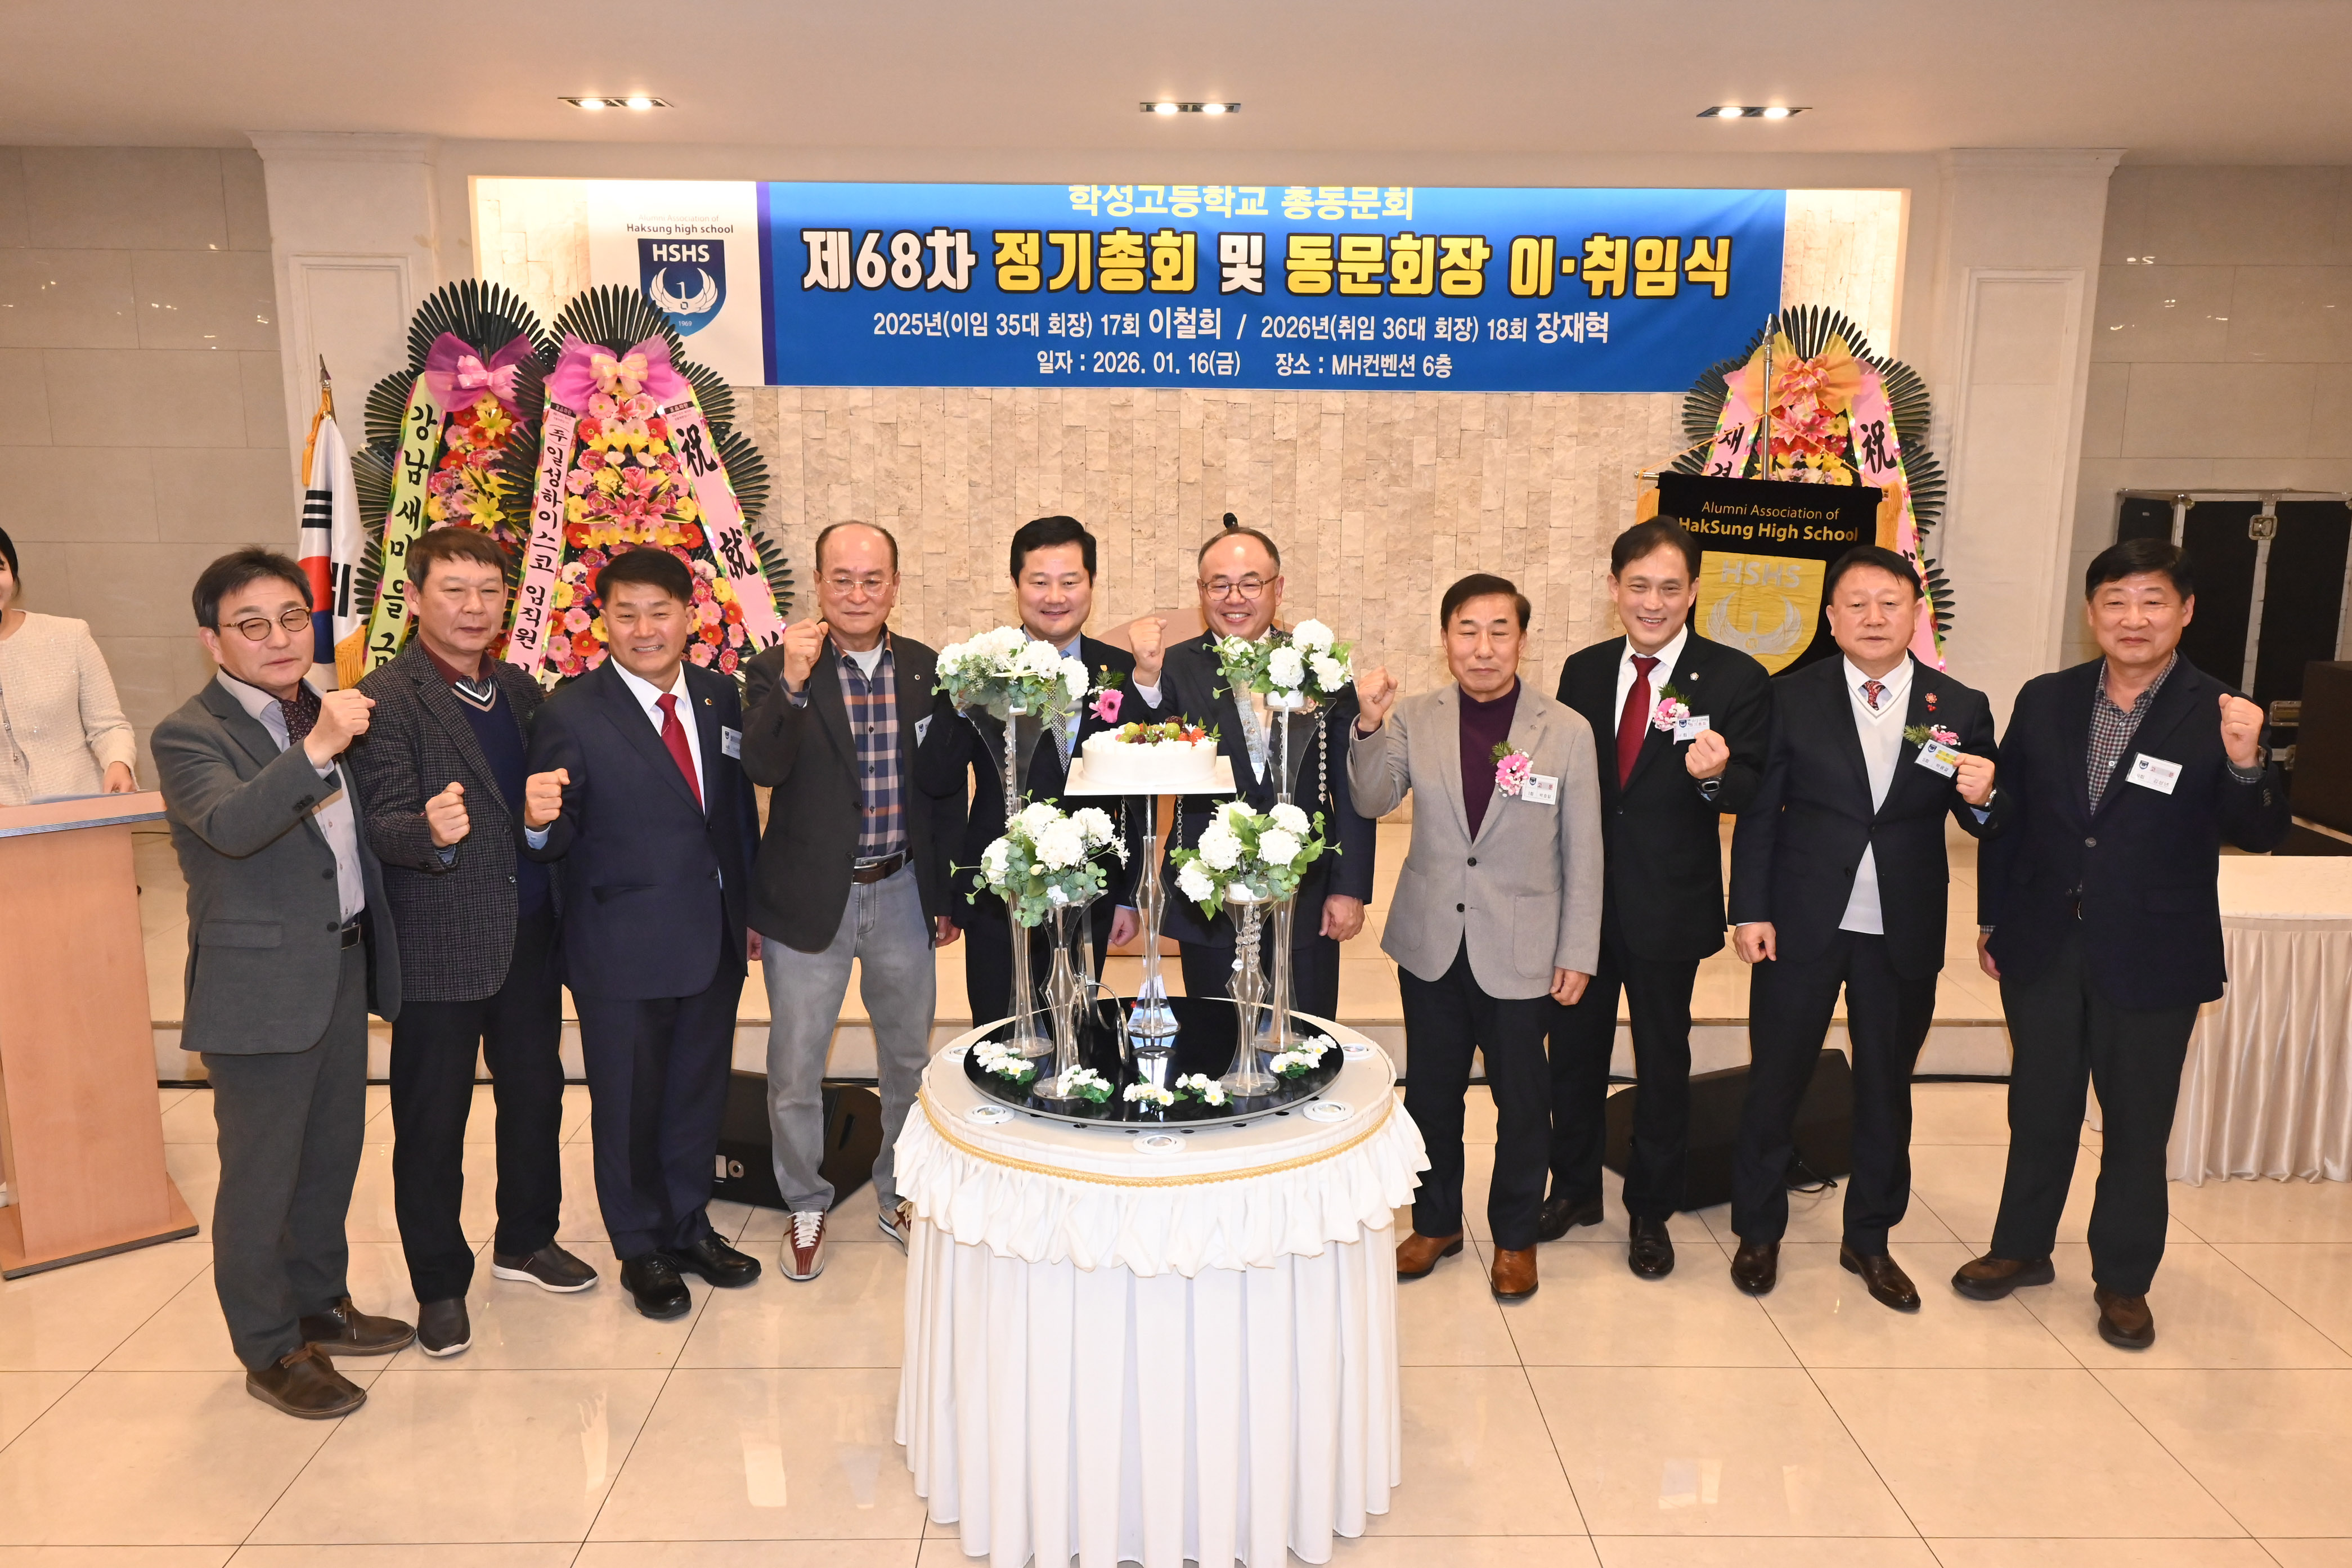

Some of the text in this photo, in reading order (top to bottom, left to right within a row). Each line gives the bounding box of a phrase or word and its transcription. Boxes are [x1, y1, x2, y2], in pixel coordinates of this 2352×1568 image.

[1069, 186, 1414, 220] 학성고등학교 총동문회
[627, 224, 733, 235] Haksung high school
[652, 244, 710, 263] HSHS
[802, 230, 976, 290] 제68차
[995, 230, 1195, 291] 정기총회
[1220, 235, 1263, 293] 및
[1286, 233, 1490, 295] 동문회장
[874, 313, 988, 338] 2025년(이임
[996, 312, 1039, 337] 35대
[1048, 312, 1093, 338] 회장)
[1101, 313, 1139, 338] 17회
[1148, 307, 1221, 340] 이철희
[1261, 315, 1375, 342] 2026년(취임
[1383, 316, 1426, 341] 36대
[1434, 316, 1479, 343] 회장)
[1487, 317, 1527, 342] 18회
[1536, 311, 1609, 344] 장재혁
[1037, 350, 1073, 374] 일자
[1093, 351, 1146, 374] 2026.
[1153, 352, 1180, 374] 01.
[1188, 350, 1240, 376] 16(금)
[1275, 352, 1311, 376] 장소
[1332, 353, 1415, 377] MH컨벤션
[1423, 353, 1453, 378] 6층
[1702, 501, 1840, 520] Alumni Association of
[1679, 517, 1857, 542] HakSung High School
[1720, 560, 1802, 588] HSHS
[514, 585, 546, 650] 임직원
